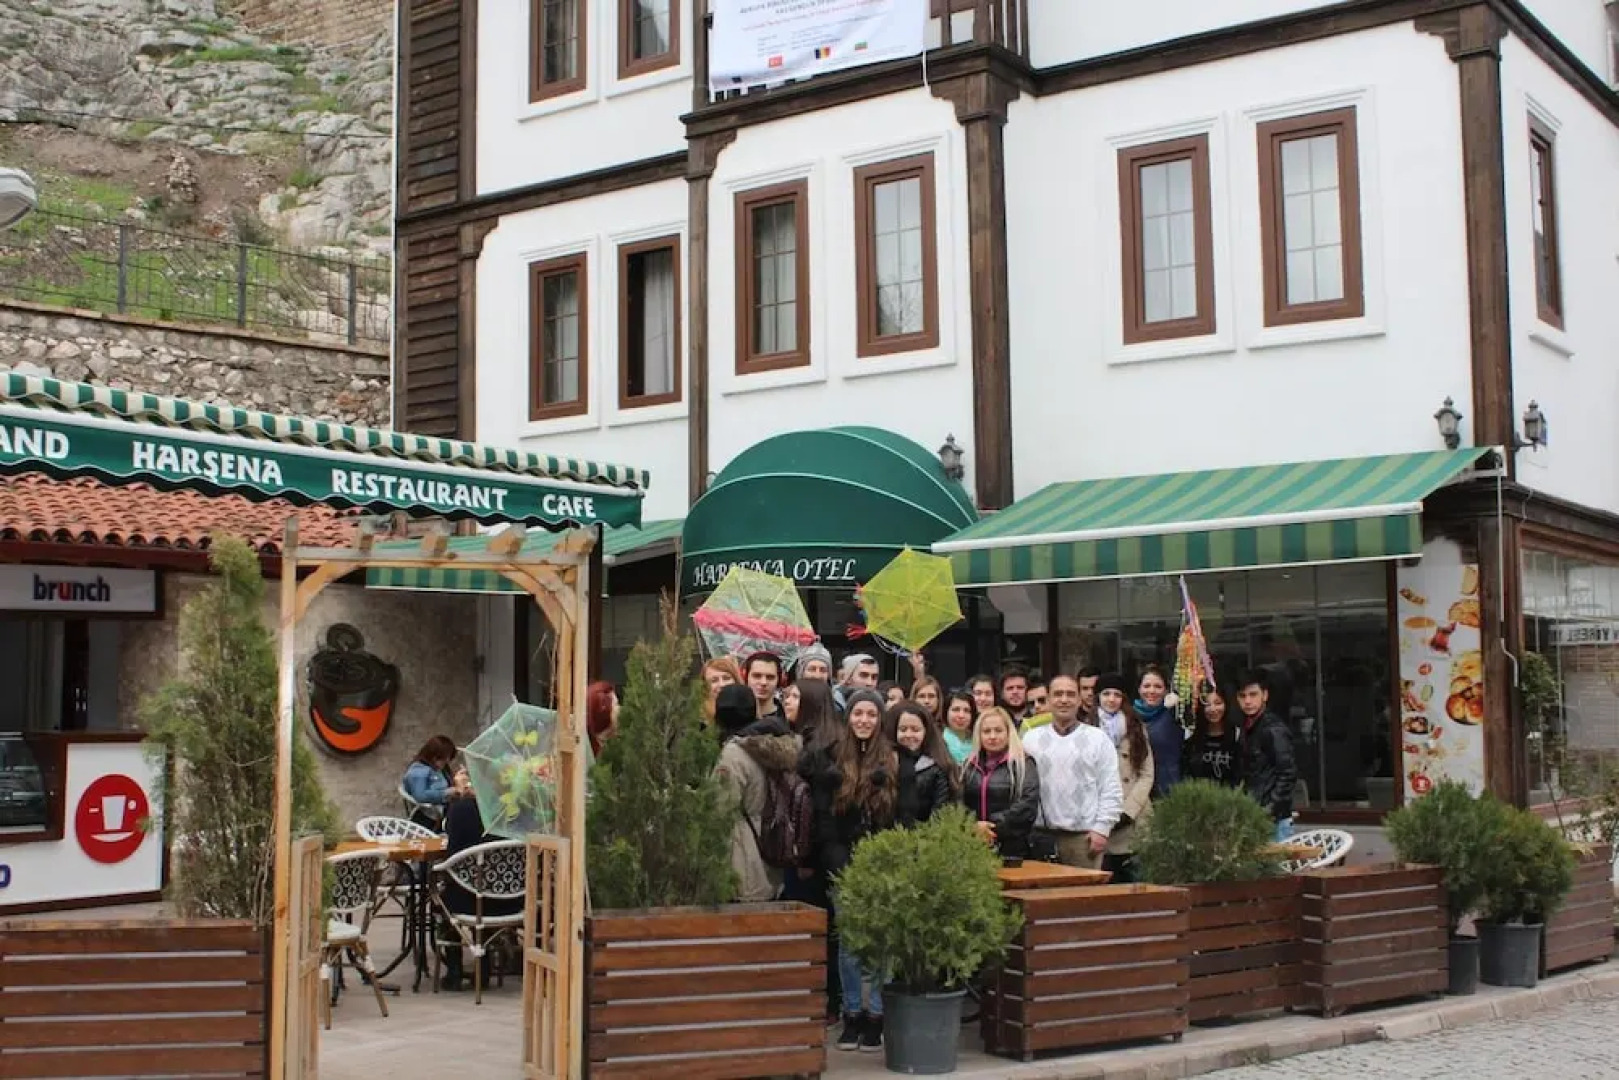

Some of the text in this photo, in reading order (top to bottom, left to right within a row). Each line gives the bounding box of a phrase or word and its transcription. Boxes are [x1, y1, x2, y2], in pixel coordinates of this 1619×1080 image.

[132, 440, 284, 485] HARŞENA
[331, 468, 509, 511] RESTAURANT
[542, 493, 597, 518] CAFE
[793, 556, 857, 581] OTEL
[33, 573, 110, 602] brunch
